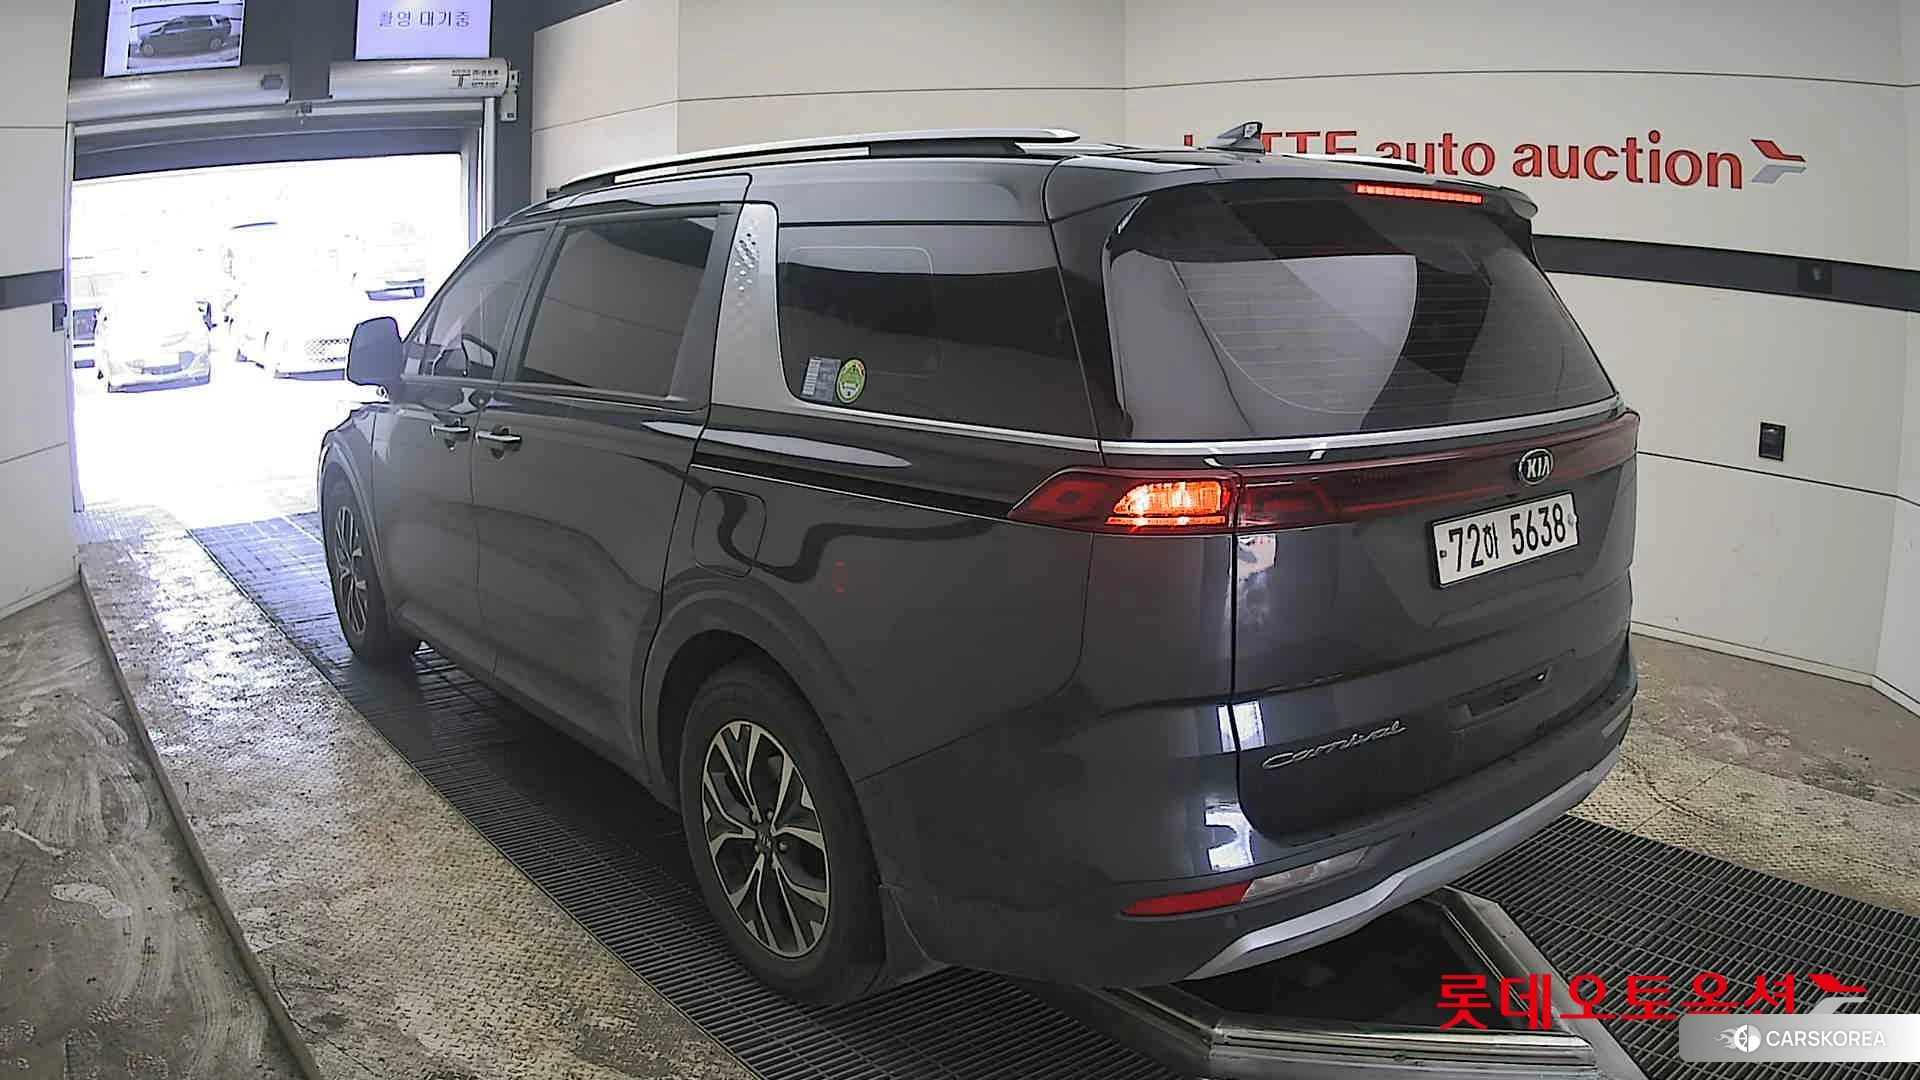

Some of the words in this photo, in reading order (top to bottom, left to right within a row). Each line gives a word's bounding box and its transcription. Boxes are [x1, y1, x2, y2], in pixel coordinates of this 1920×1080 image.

[1375, 132, 1496, 175] auto
[1512, 129, 1742, 190] auction
[1526, 456, 1551, 479] KIA
[1448, 522, 1499, 572] 72하
[1510, 503, 1566, 555] 5638
